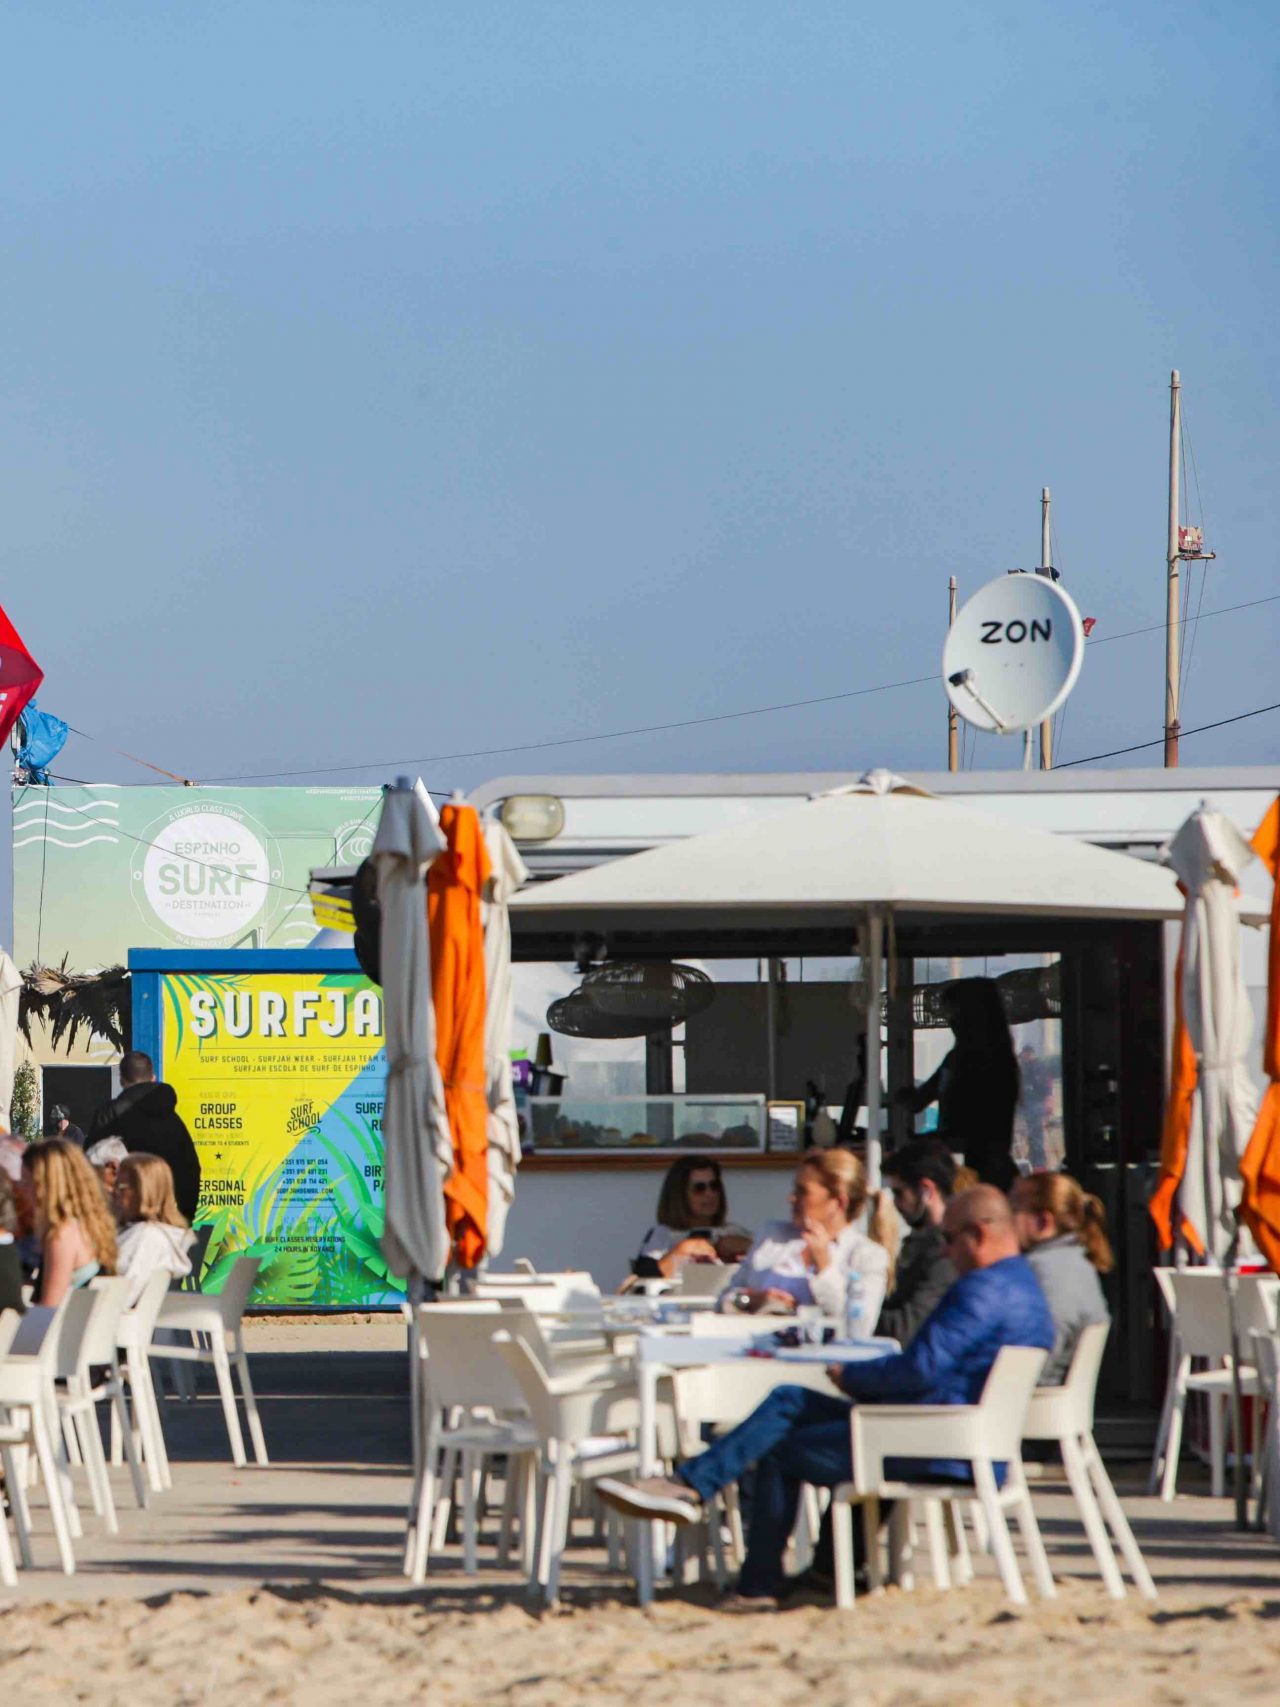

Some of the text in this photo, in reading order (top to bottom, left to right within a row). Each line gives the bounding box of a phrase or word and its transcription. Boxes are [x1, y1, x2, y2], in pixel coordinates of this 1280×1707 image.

[981, 618, 1051, 644] ZON
[174, 805, 201, 818] WORLD
[201, 804, 224, 813] CLASS
[223, 808, 244, 822] WAVE
[174, 842, 241, 855] ESPINHO
[158, 863, 258, 896] SURF
[172, 900, 244, 910] DESTINATION
[190, 989, 383, 1038] SURFJA
[200, 1055, 218, 1063] SURF
[221, 1055, 249, 1063] SCHOOL
[258, 1055, 291, 1063] SURFJAH
[294, 1055, 315, 1063] WEAR
[323, 1055, 356, 1063] SURFJAH
[359, 1055, 380, 1063] TEAM
[233, 1065, 376, 1073] SURFJAH ESCOLA DE SURF DE ESPINHO
[200, 1103, 237, 1115] GROUP
[290, 1101, 315, 1119] SURF
[194, 1117, 243, 1129] CLASSES
[286, 1111, 322, 1133] SCHOOL
[364, 1165, 384, 1177] BIR
[199, 1180, 247, 1191] ERSONAL
[200, 1194, 244, 1206] RAINING
